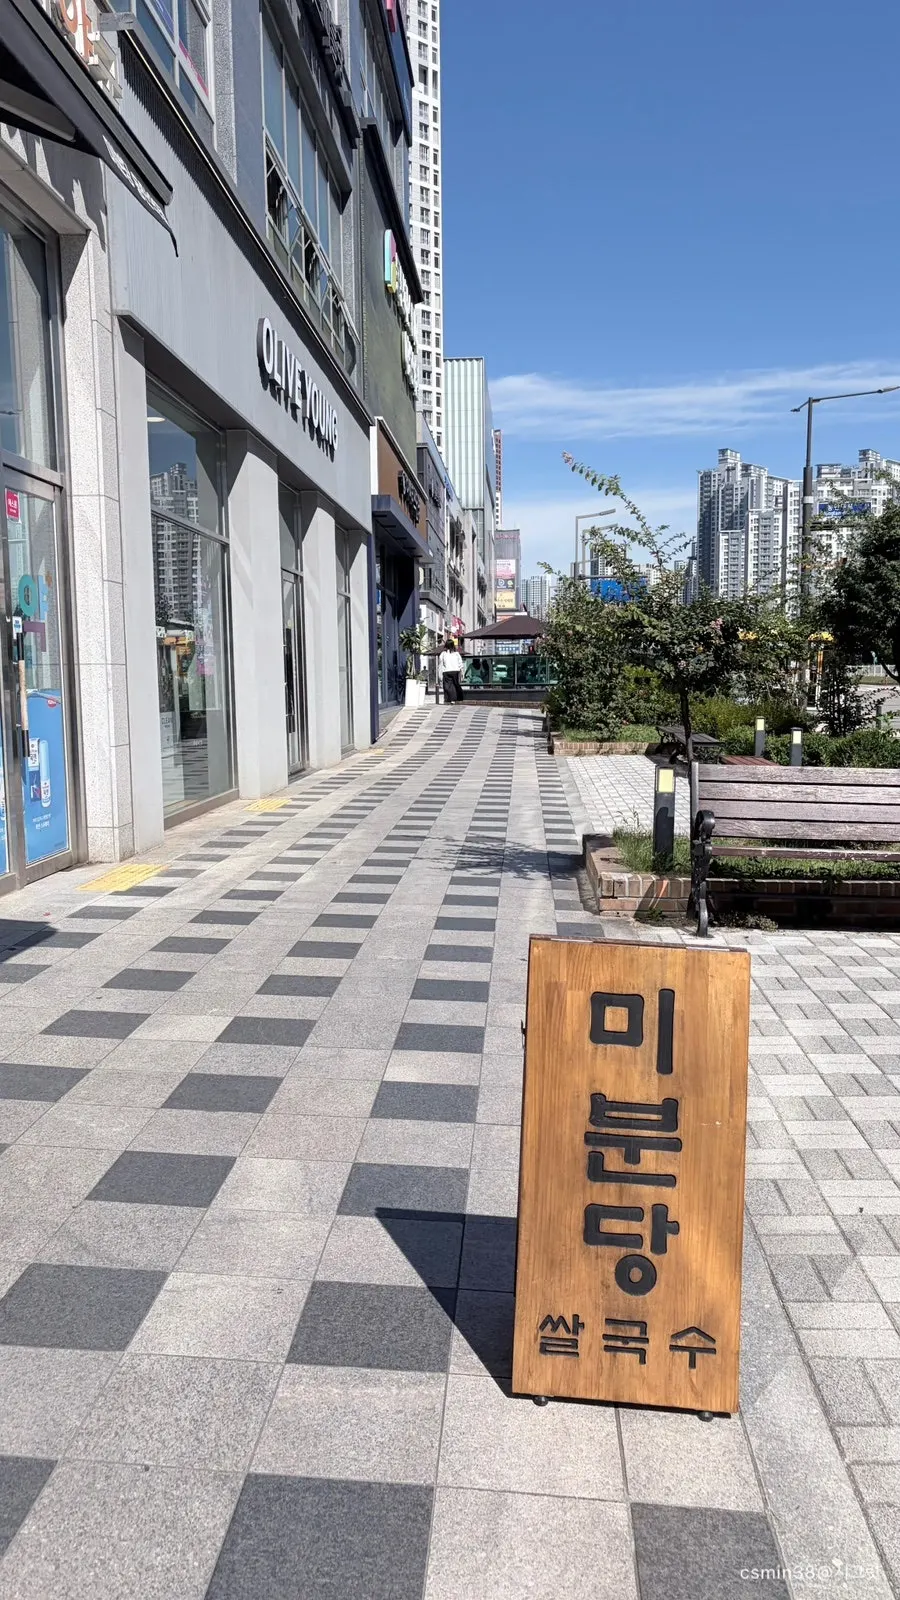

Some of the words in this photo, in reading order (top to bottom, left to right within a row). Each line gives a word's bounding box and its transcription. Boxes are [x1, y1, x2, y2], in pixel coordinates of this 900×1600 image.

[258, 317, 302, 409] OLIVE
[301, 369, 338, 451] YOUNG
[584, 988, 682, 1296] 미분당
[539, 1313, 717, 1370] 쌀국수
